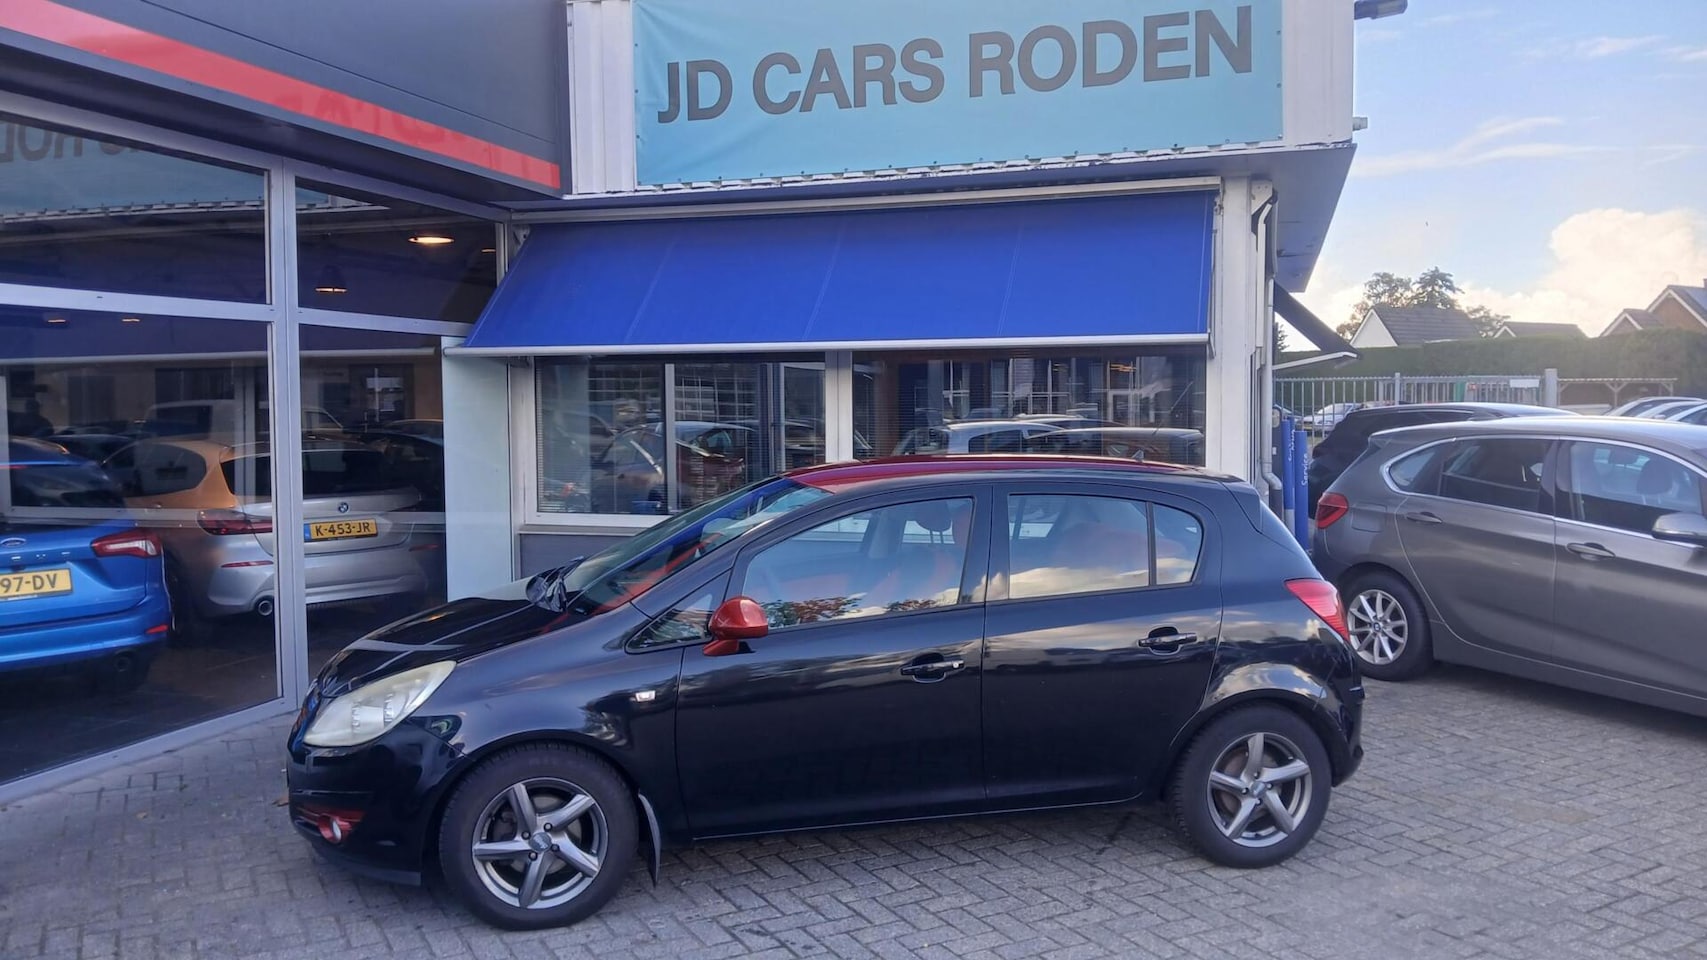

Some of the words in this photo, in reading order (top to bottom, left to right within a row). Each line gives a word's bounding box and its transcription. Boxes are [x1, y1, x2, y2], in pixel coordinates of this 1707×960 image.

[658, 60, 733, 123] JD
[753, 38, 945, 114] CARS
[969, 5, 1252, 97] RODEN
[315, 522, 371, 536] K-453-JR
